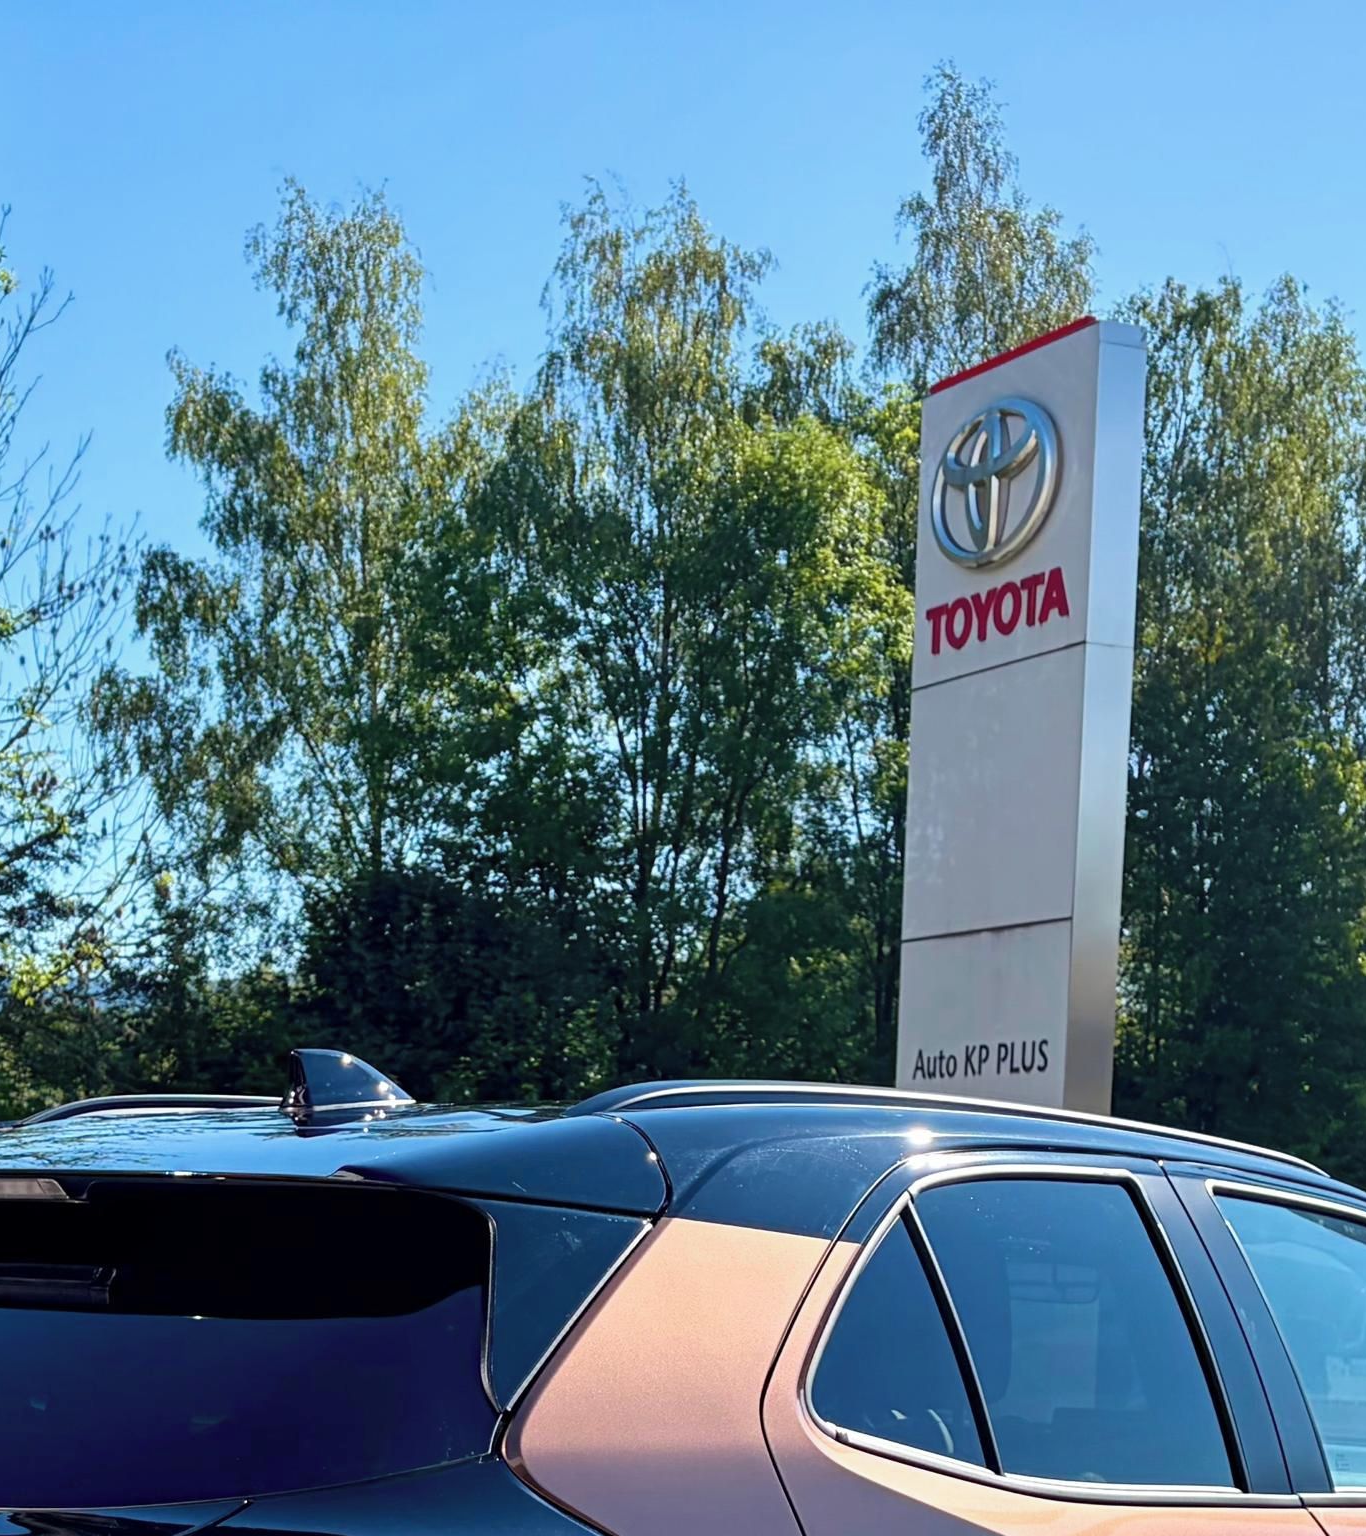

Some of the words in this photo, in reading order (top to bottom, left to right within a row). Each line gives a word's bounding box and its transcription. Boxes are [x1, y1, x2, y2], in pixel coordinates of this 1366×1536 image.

[926, 567, 1069, 655] TOYOTA
[912, 1049, 958, 1080] Auto
[964, 1045, 989, 1077] KP
[996, 1039, 1048, 1075] PLUS
